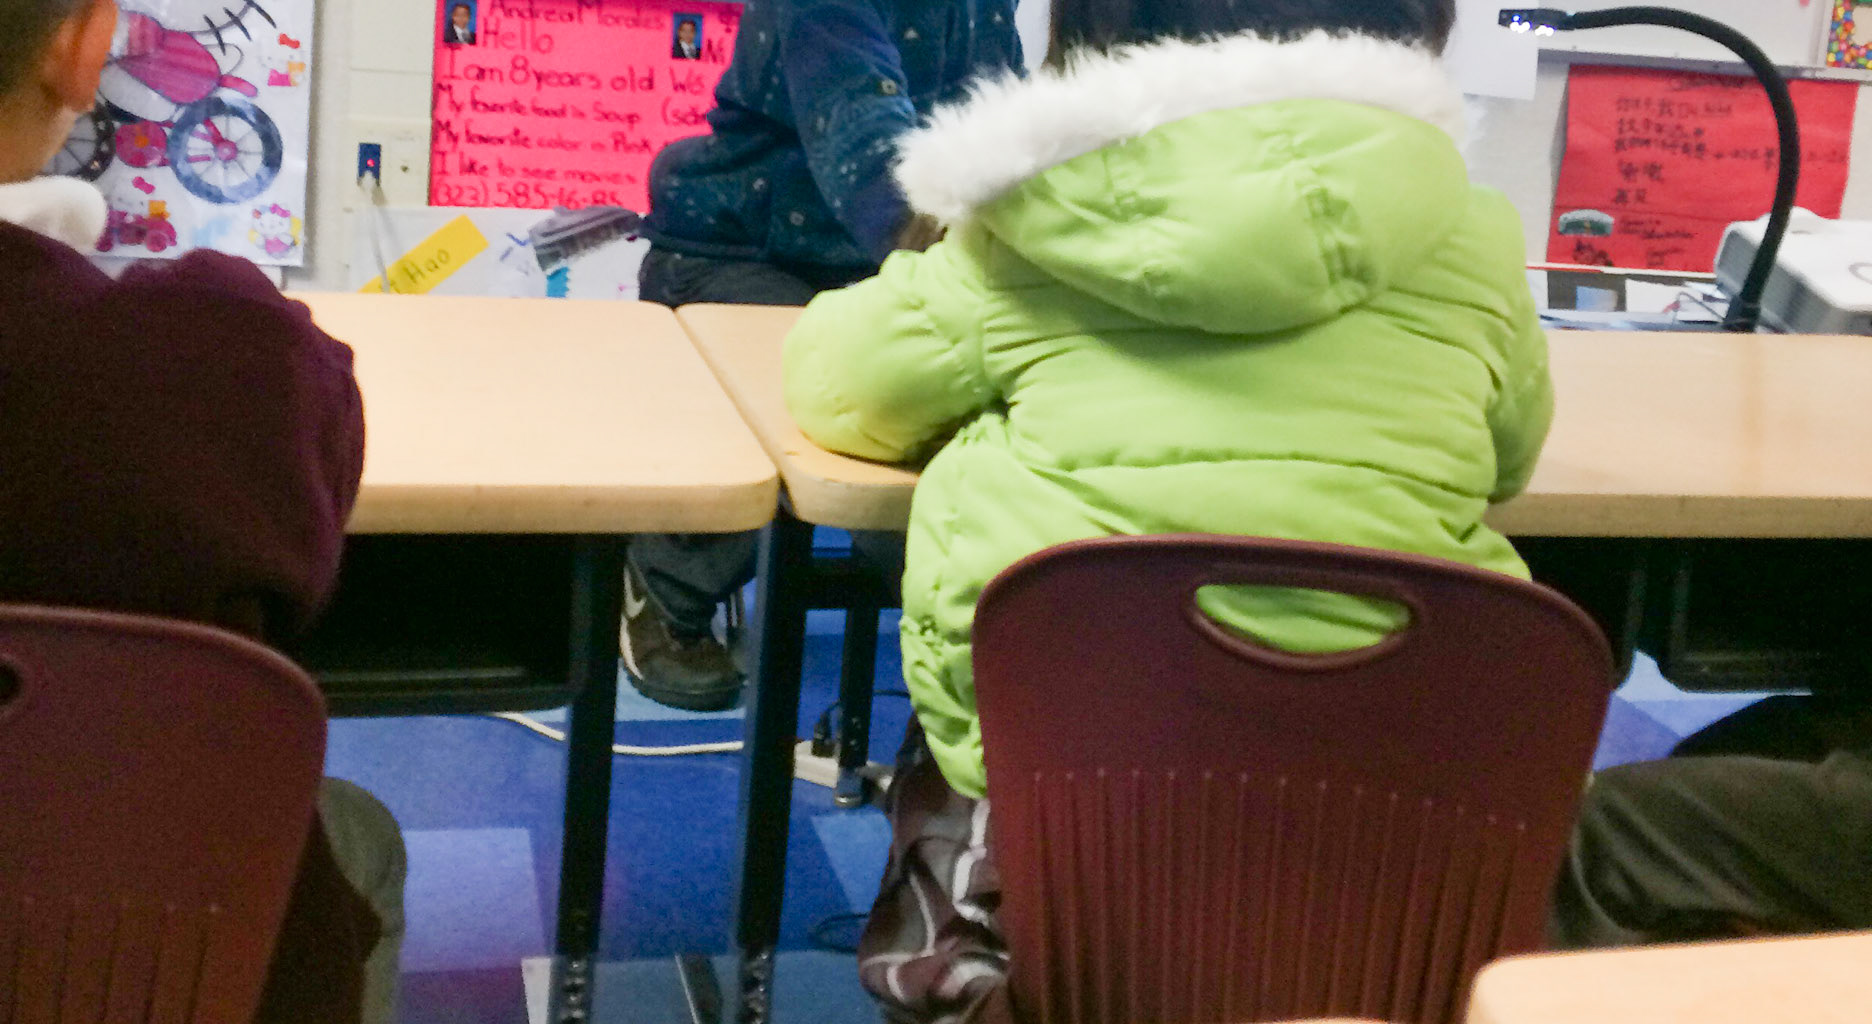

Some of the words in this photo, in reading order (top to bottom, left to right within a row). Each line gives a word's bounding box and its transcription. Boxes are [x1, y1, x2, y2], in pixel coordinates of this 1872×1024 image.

[483, 16, 555, 55] Hello
[463, 62, 504, 83] am
[509, 54, 531, 85] 8
[531, 69, 602, 92] years
[610, 65, 655, 93] old
[435, 119, 459, 152] My
[401, 247, 452, 285] Hao
